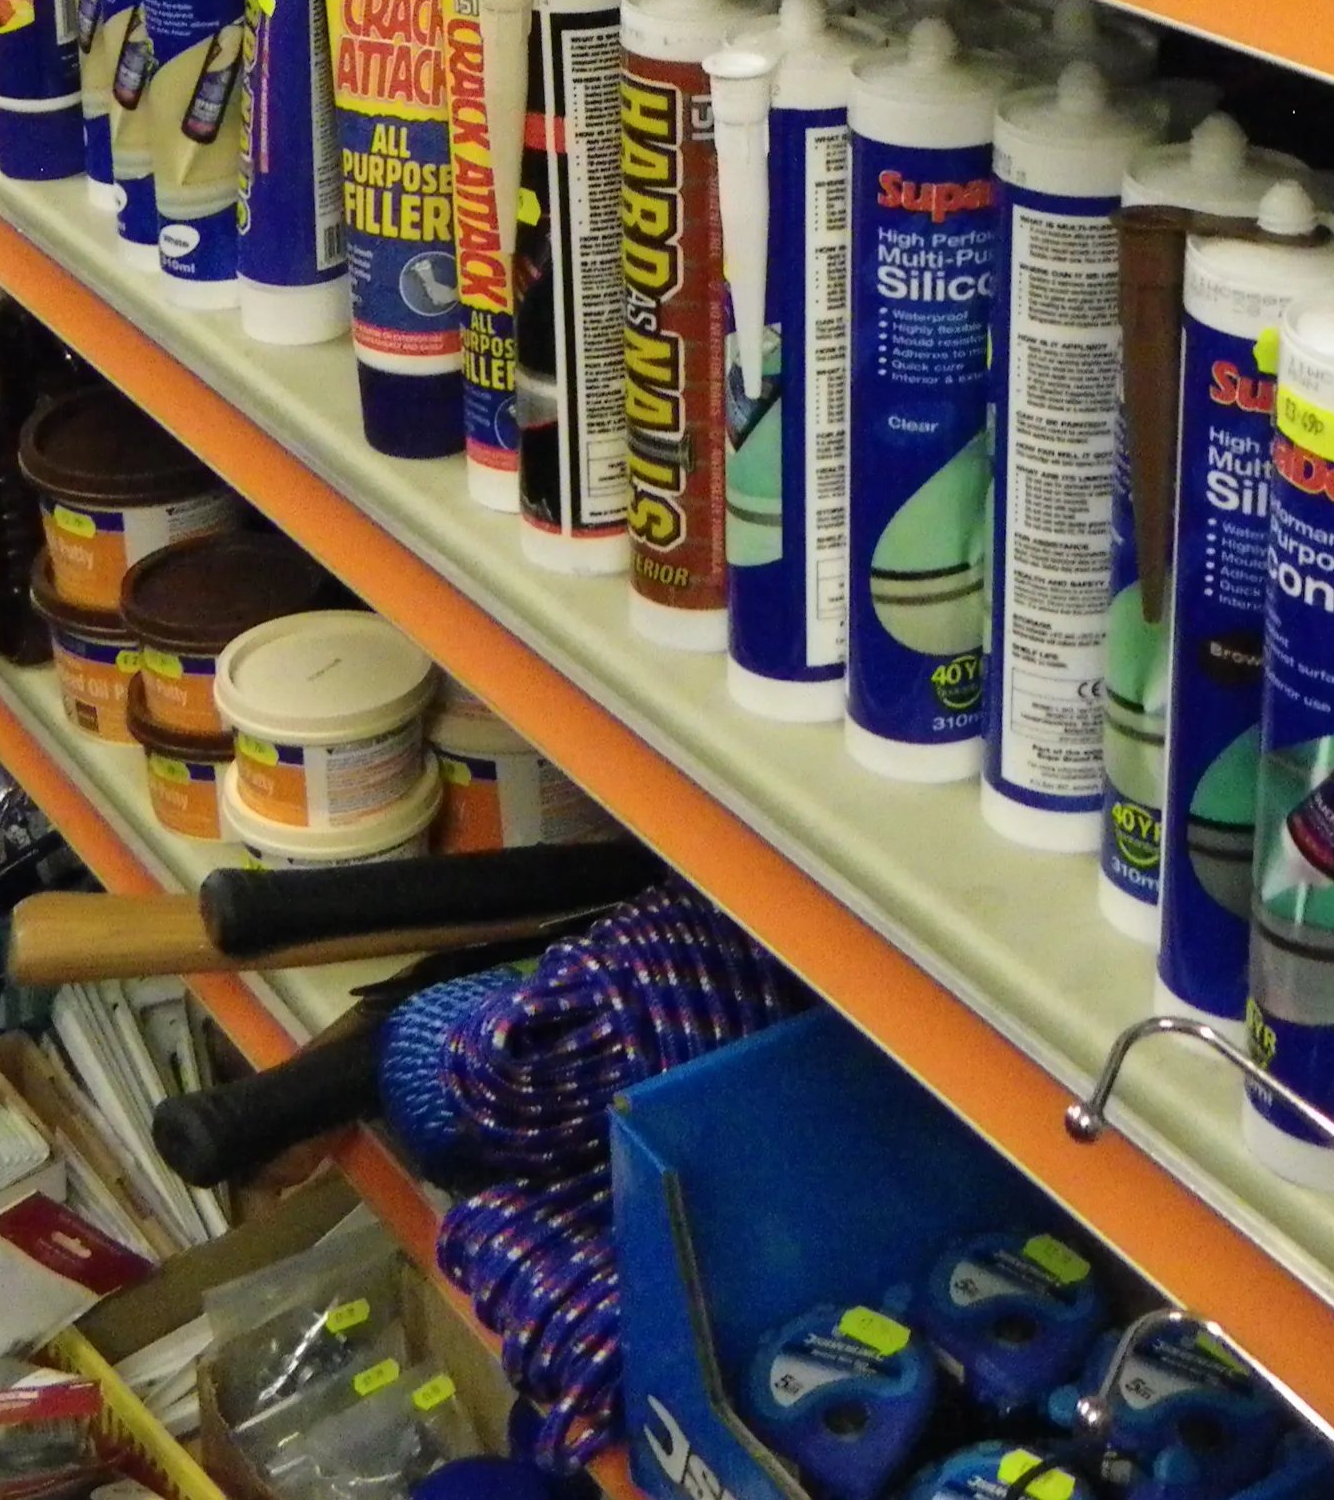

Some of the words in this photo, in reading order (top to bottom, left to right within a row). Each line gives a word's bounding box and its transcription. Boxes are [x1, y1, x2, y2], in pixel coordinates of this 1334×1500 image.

[371, 123, 411, 159] ALL
[342, 148, 453, 195] PURPOSE
[343, 181, 453, 242] FILLER
[877, 226, 925, 248] High
[888, 416, 939, 434] Clear
[1209, 426, 1261, 454] High
